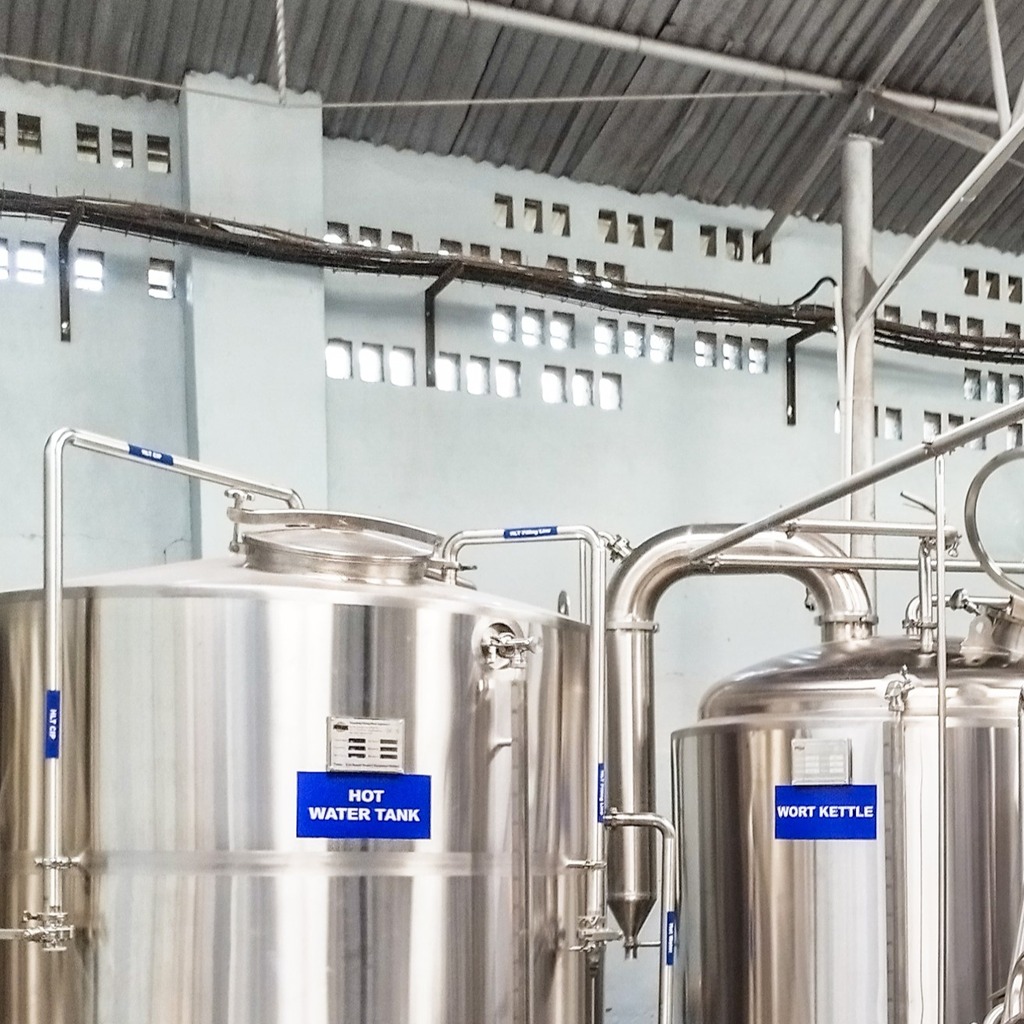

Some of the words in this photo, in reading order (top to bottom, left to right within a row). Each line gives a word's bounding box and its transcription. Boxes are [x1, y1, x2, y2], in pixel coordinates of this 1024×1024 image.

[49, 708, 57, 725] HLT
[348, 789, 385, 803] HOT
[308, 807, 371, 821] WATER
[374, 808, 420, 822] TANK
[777, 805, 816, 818] WORT
[819, 805, 874, 818] KETTLE
